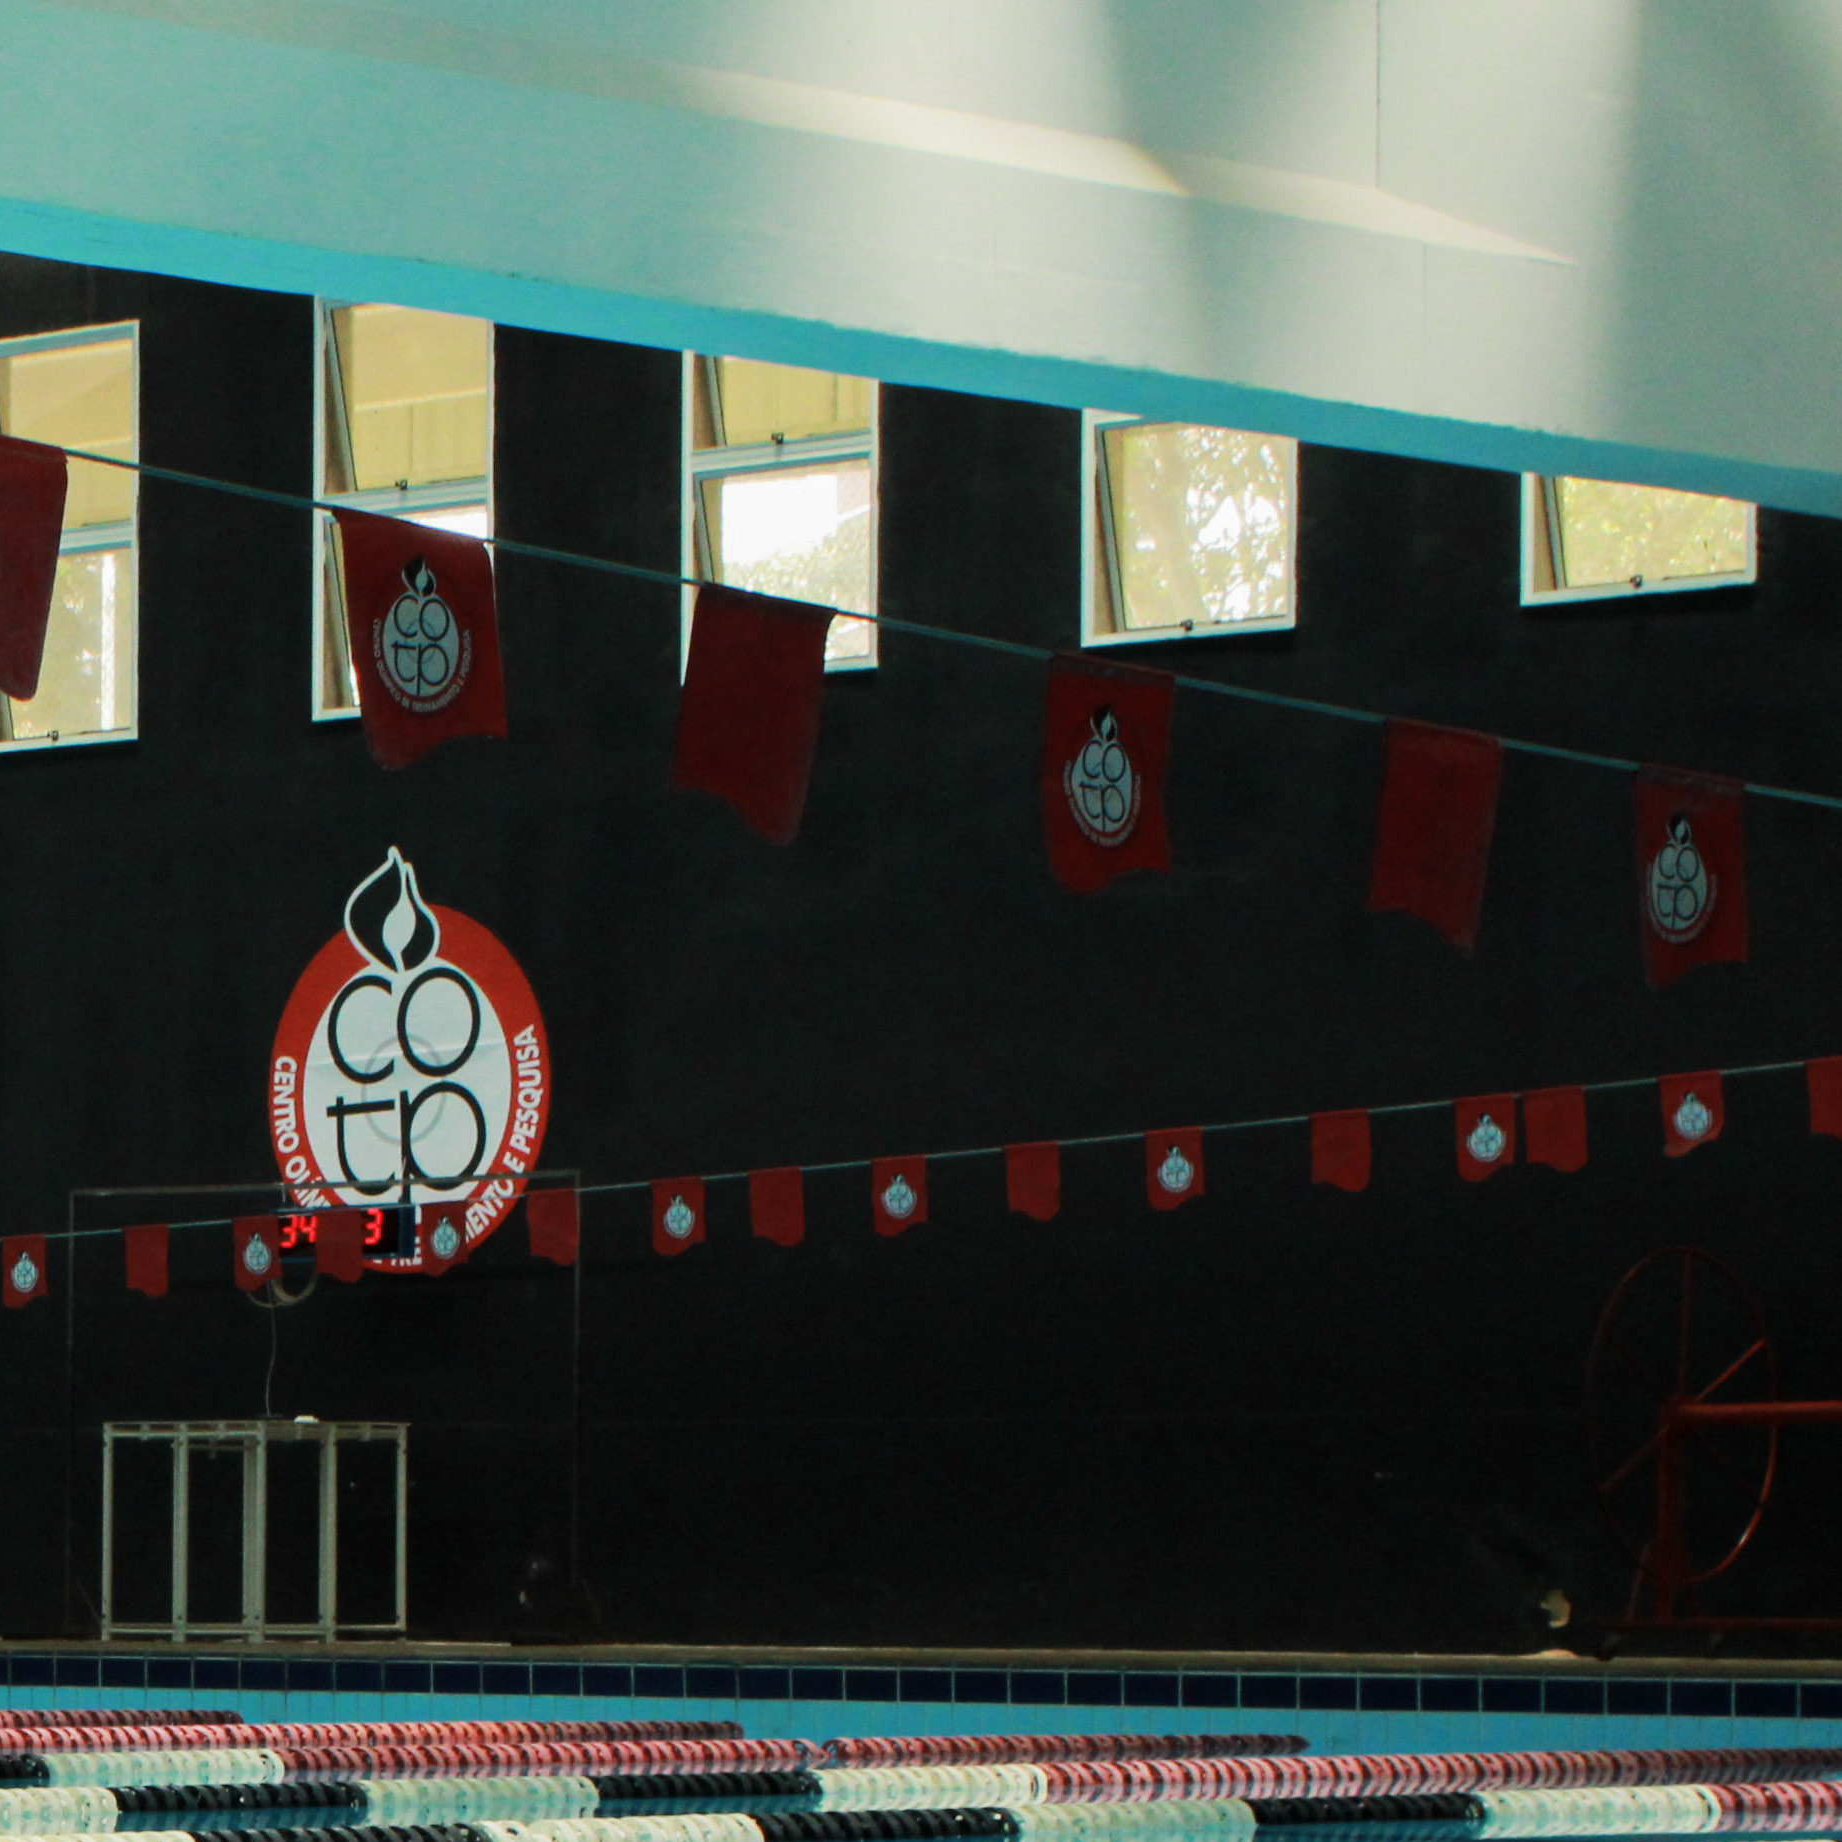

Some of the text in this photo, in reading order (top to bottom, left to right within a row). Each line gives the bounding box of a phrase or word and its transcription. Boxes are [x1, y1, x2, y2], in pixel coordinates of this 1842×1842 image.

[273, 1055, 300, 1154] CENTRO
[503, 1024, 543, 1174] E PESQUISA
